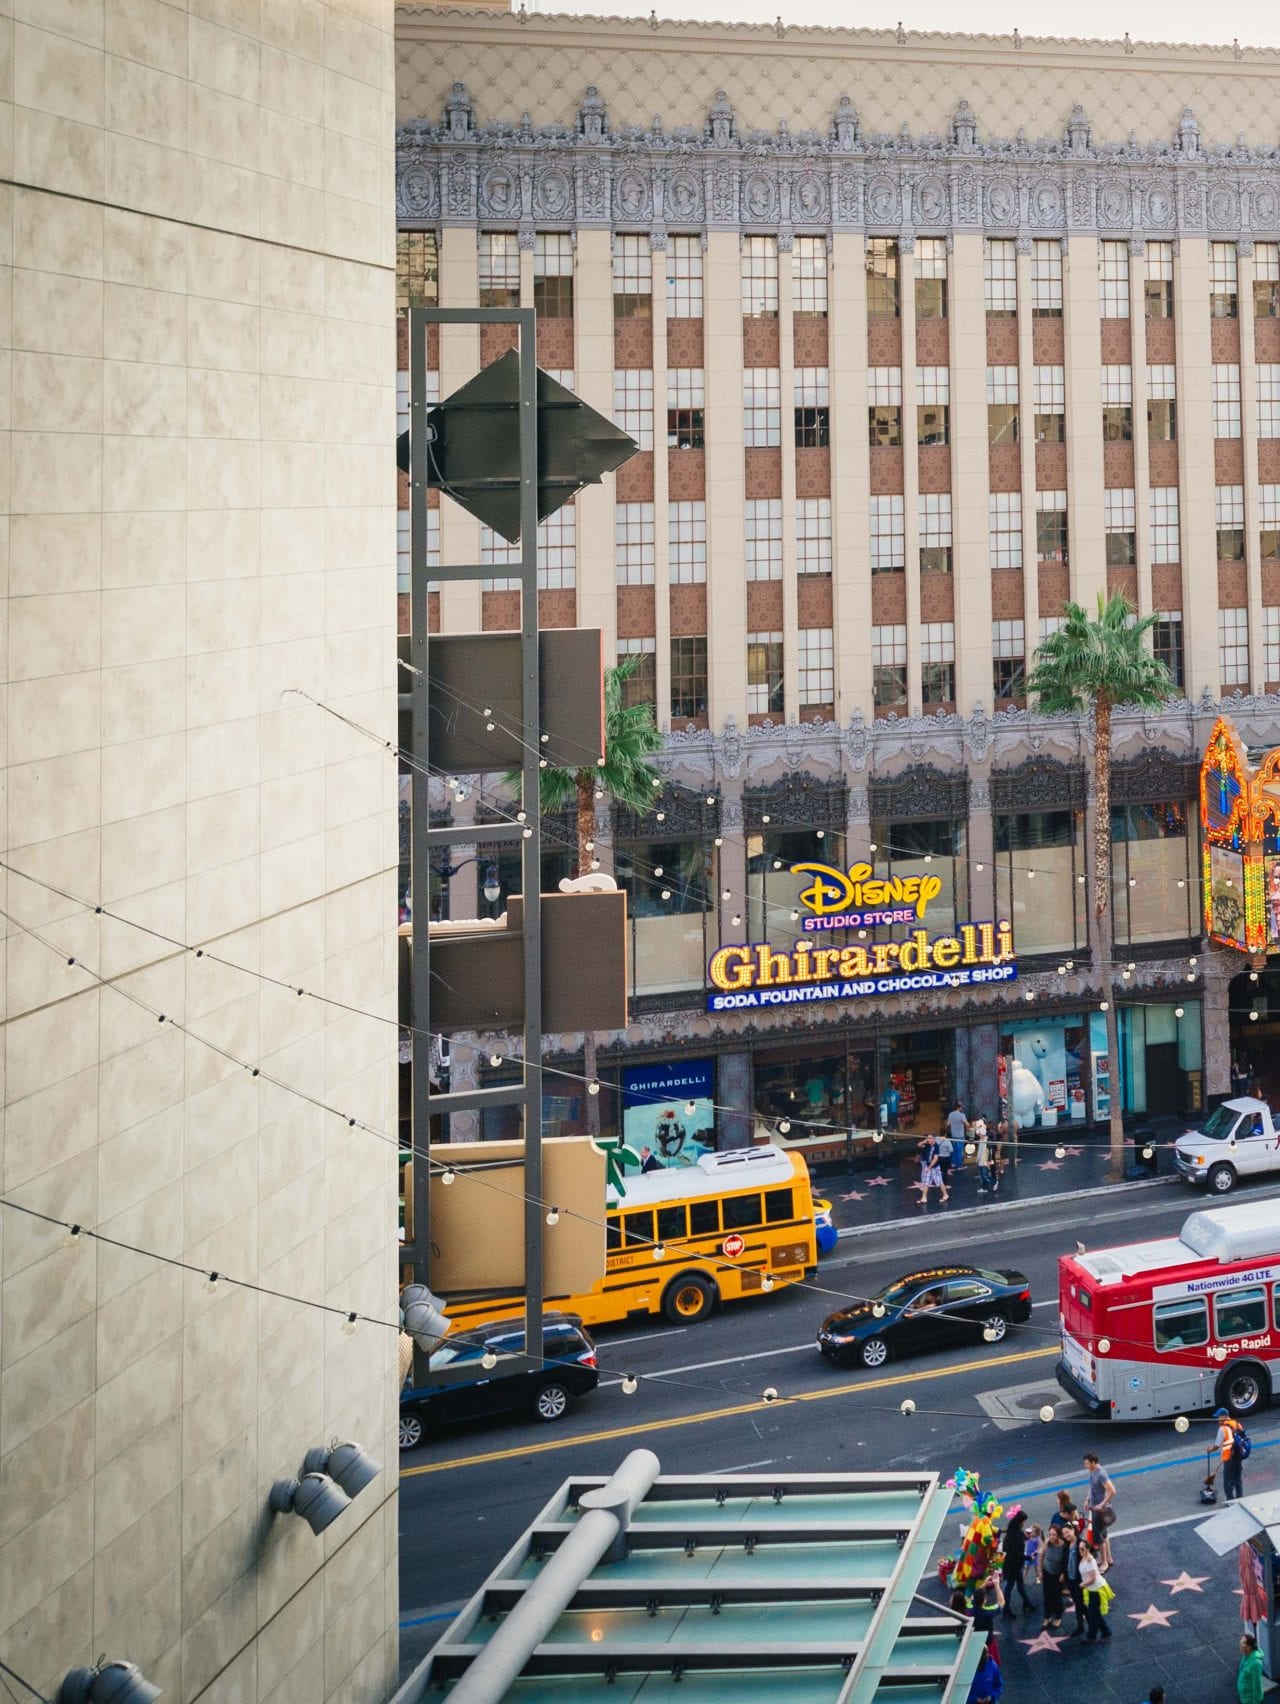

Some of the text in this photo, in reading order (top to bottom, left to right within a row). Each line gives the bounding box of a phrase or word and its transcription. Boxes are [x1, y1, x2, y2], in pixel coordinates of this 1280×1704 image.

[790, 863, 941, 918] Disney
[804, 909, 913, 930] STUDIO STORE
[709, 919, 1016, 991] Ghirardelli
[714, 966, 1014, 1009] SODA FOUNTAIN AND CHOCOLATE SHOP
[630, 1076, 706, 1091] GHIRARDELLI
[726, 1241, 742, 1252] STOP
[1187, 1276, 1241, 1293] Nationwide
[1241, 1273, 1255, 1283] 4G
[1207, 1335, 1271, 1358] Mtro Rapid
